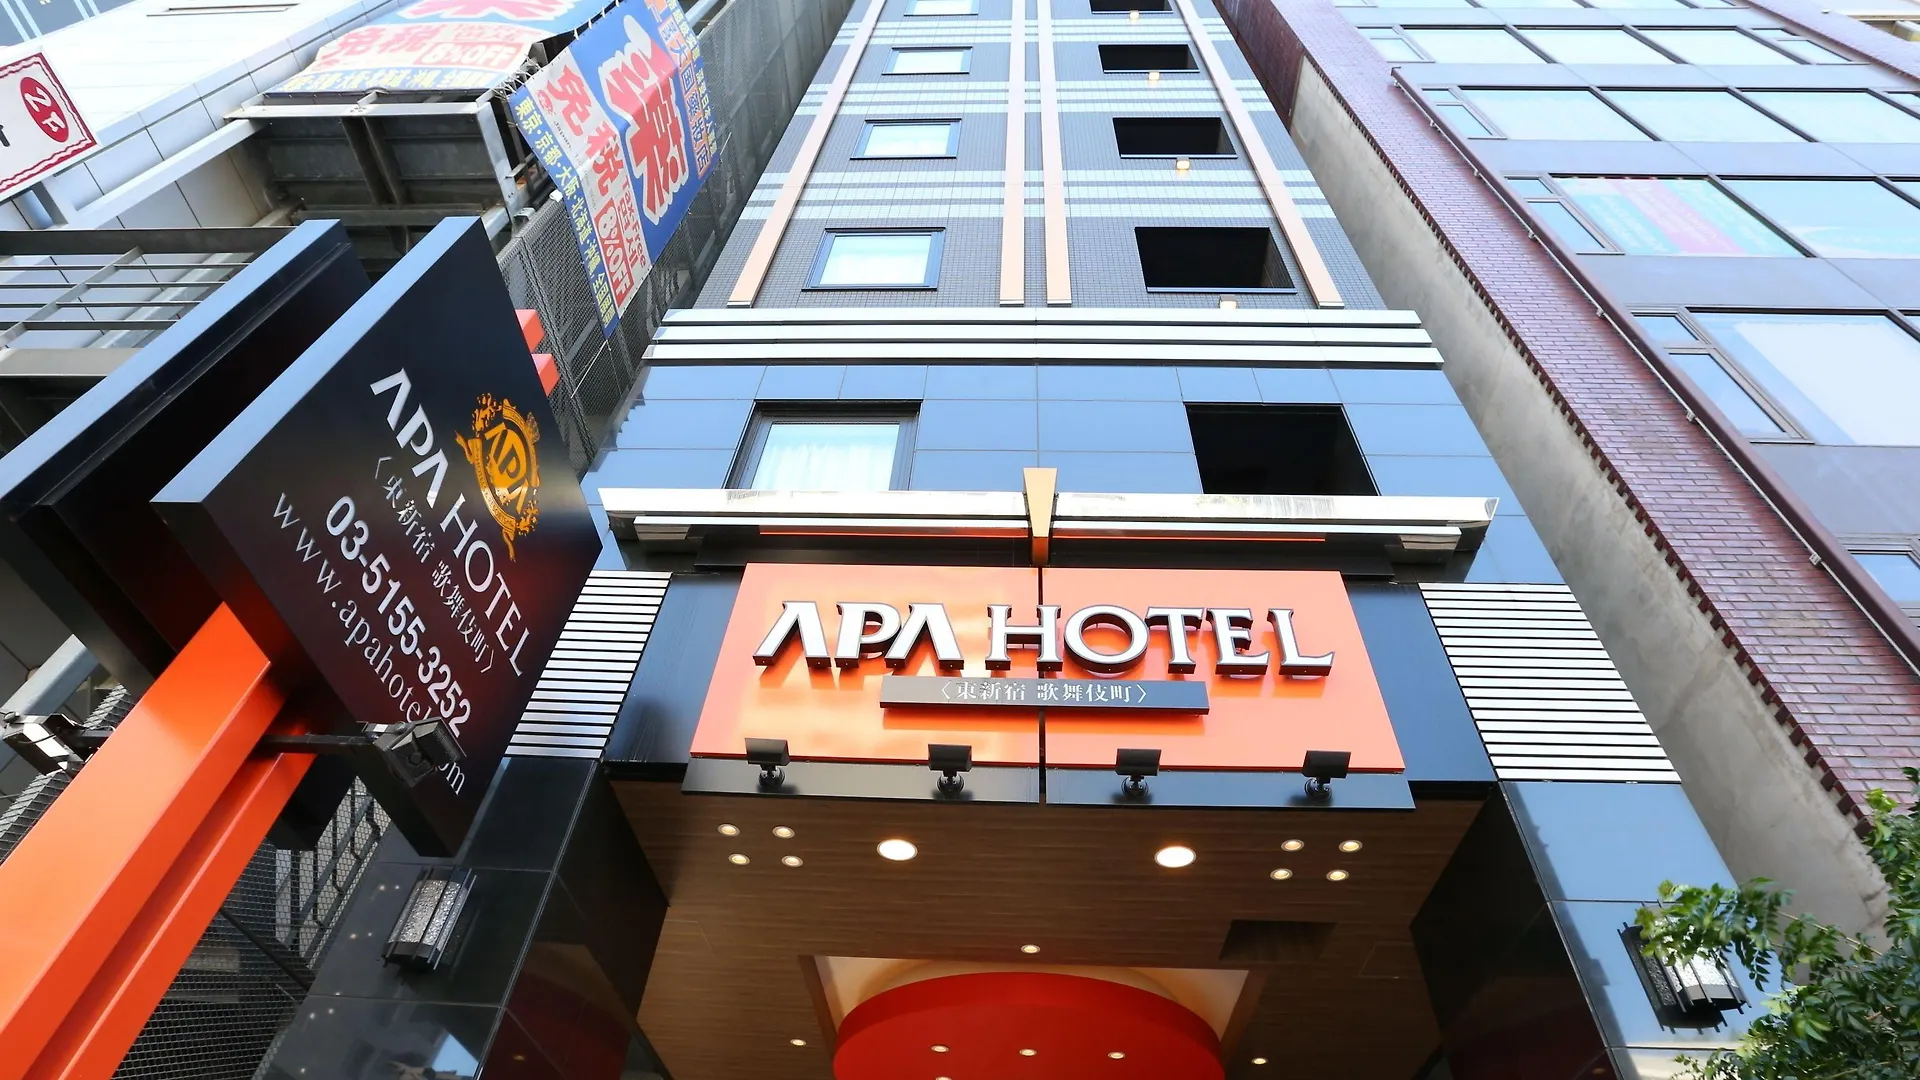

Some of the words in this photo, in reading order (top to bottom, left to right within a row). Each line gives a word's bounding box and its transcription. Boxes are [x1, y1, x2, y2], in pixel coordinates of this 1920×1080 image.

[421, 42, 514, 67] 8%OFF
[24, 86, 66, 133] 2F
[547, 64, 625, 197] 免税
[598, 205, 632, 295] 8%OFF
[370, 367, 449, 509] APA
[439, 492, 533, 677] HOTEL
[325, 495, 472, 738] 03-5155-3252
[753, 600, 964, 670] APA
[985, 603, 1336, 677] HOTEL
